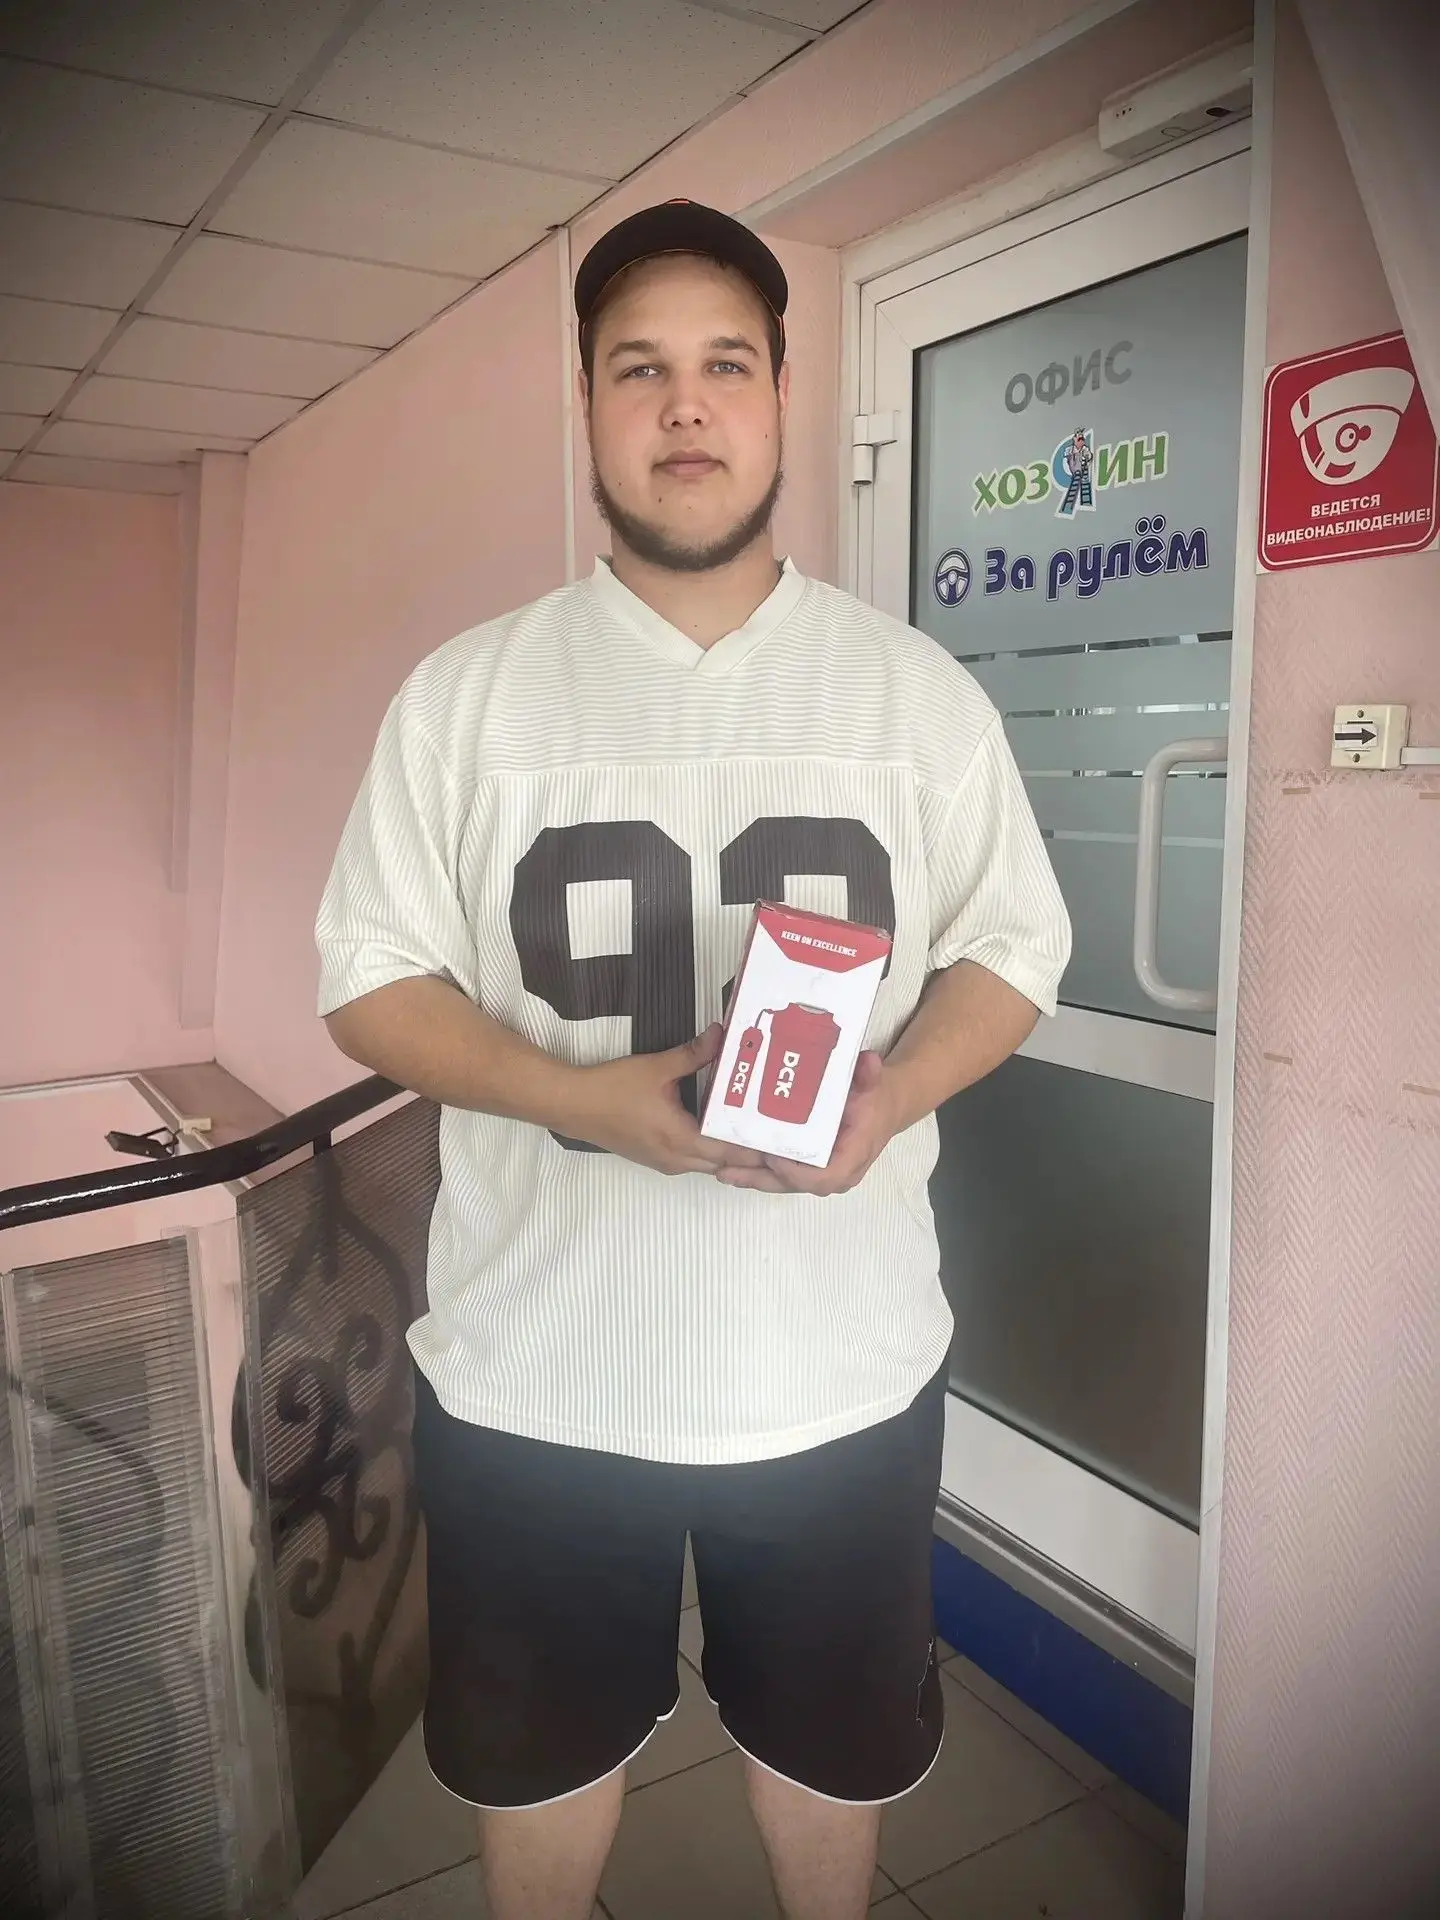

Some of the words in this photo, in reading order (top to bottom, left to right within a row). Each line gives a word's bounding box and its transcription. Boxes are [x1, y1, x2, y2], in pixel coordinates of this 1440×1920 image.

[1004, 340, 1134, 414] ОФИС
[1311, 494, 1381, 518] ВЕДЕТСЯ
[1266, 507, 1431, 546] ВИДЕОНАБЛЮДЕНИЕ!
[984, 547, 1036, 596] За
[1046, 514, 1209, 601] рулём
[781, 930, 801, 943] KEEN
[800, 936, 813, 946] ON
[812, 938, 857, 957] EXCELLENCE
[731, 1060, 750, 1095] DCK
[773, 1050, 800, 1099] DCK
